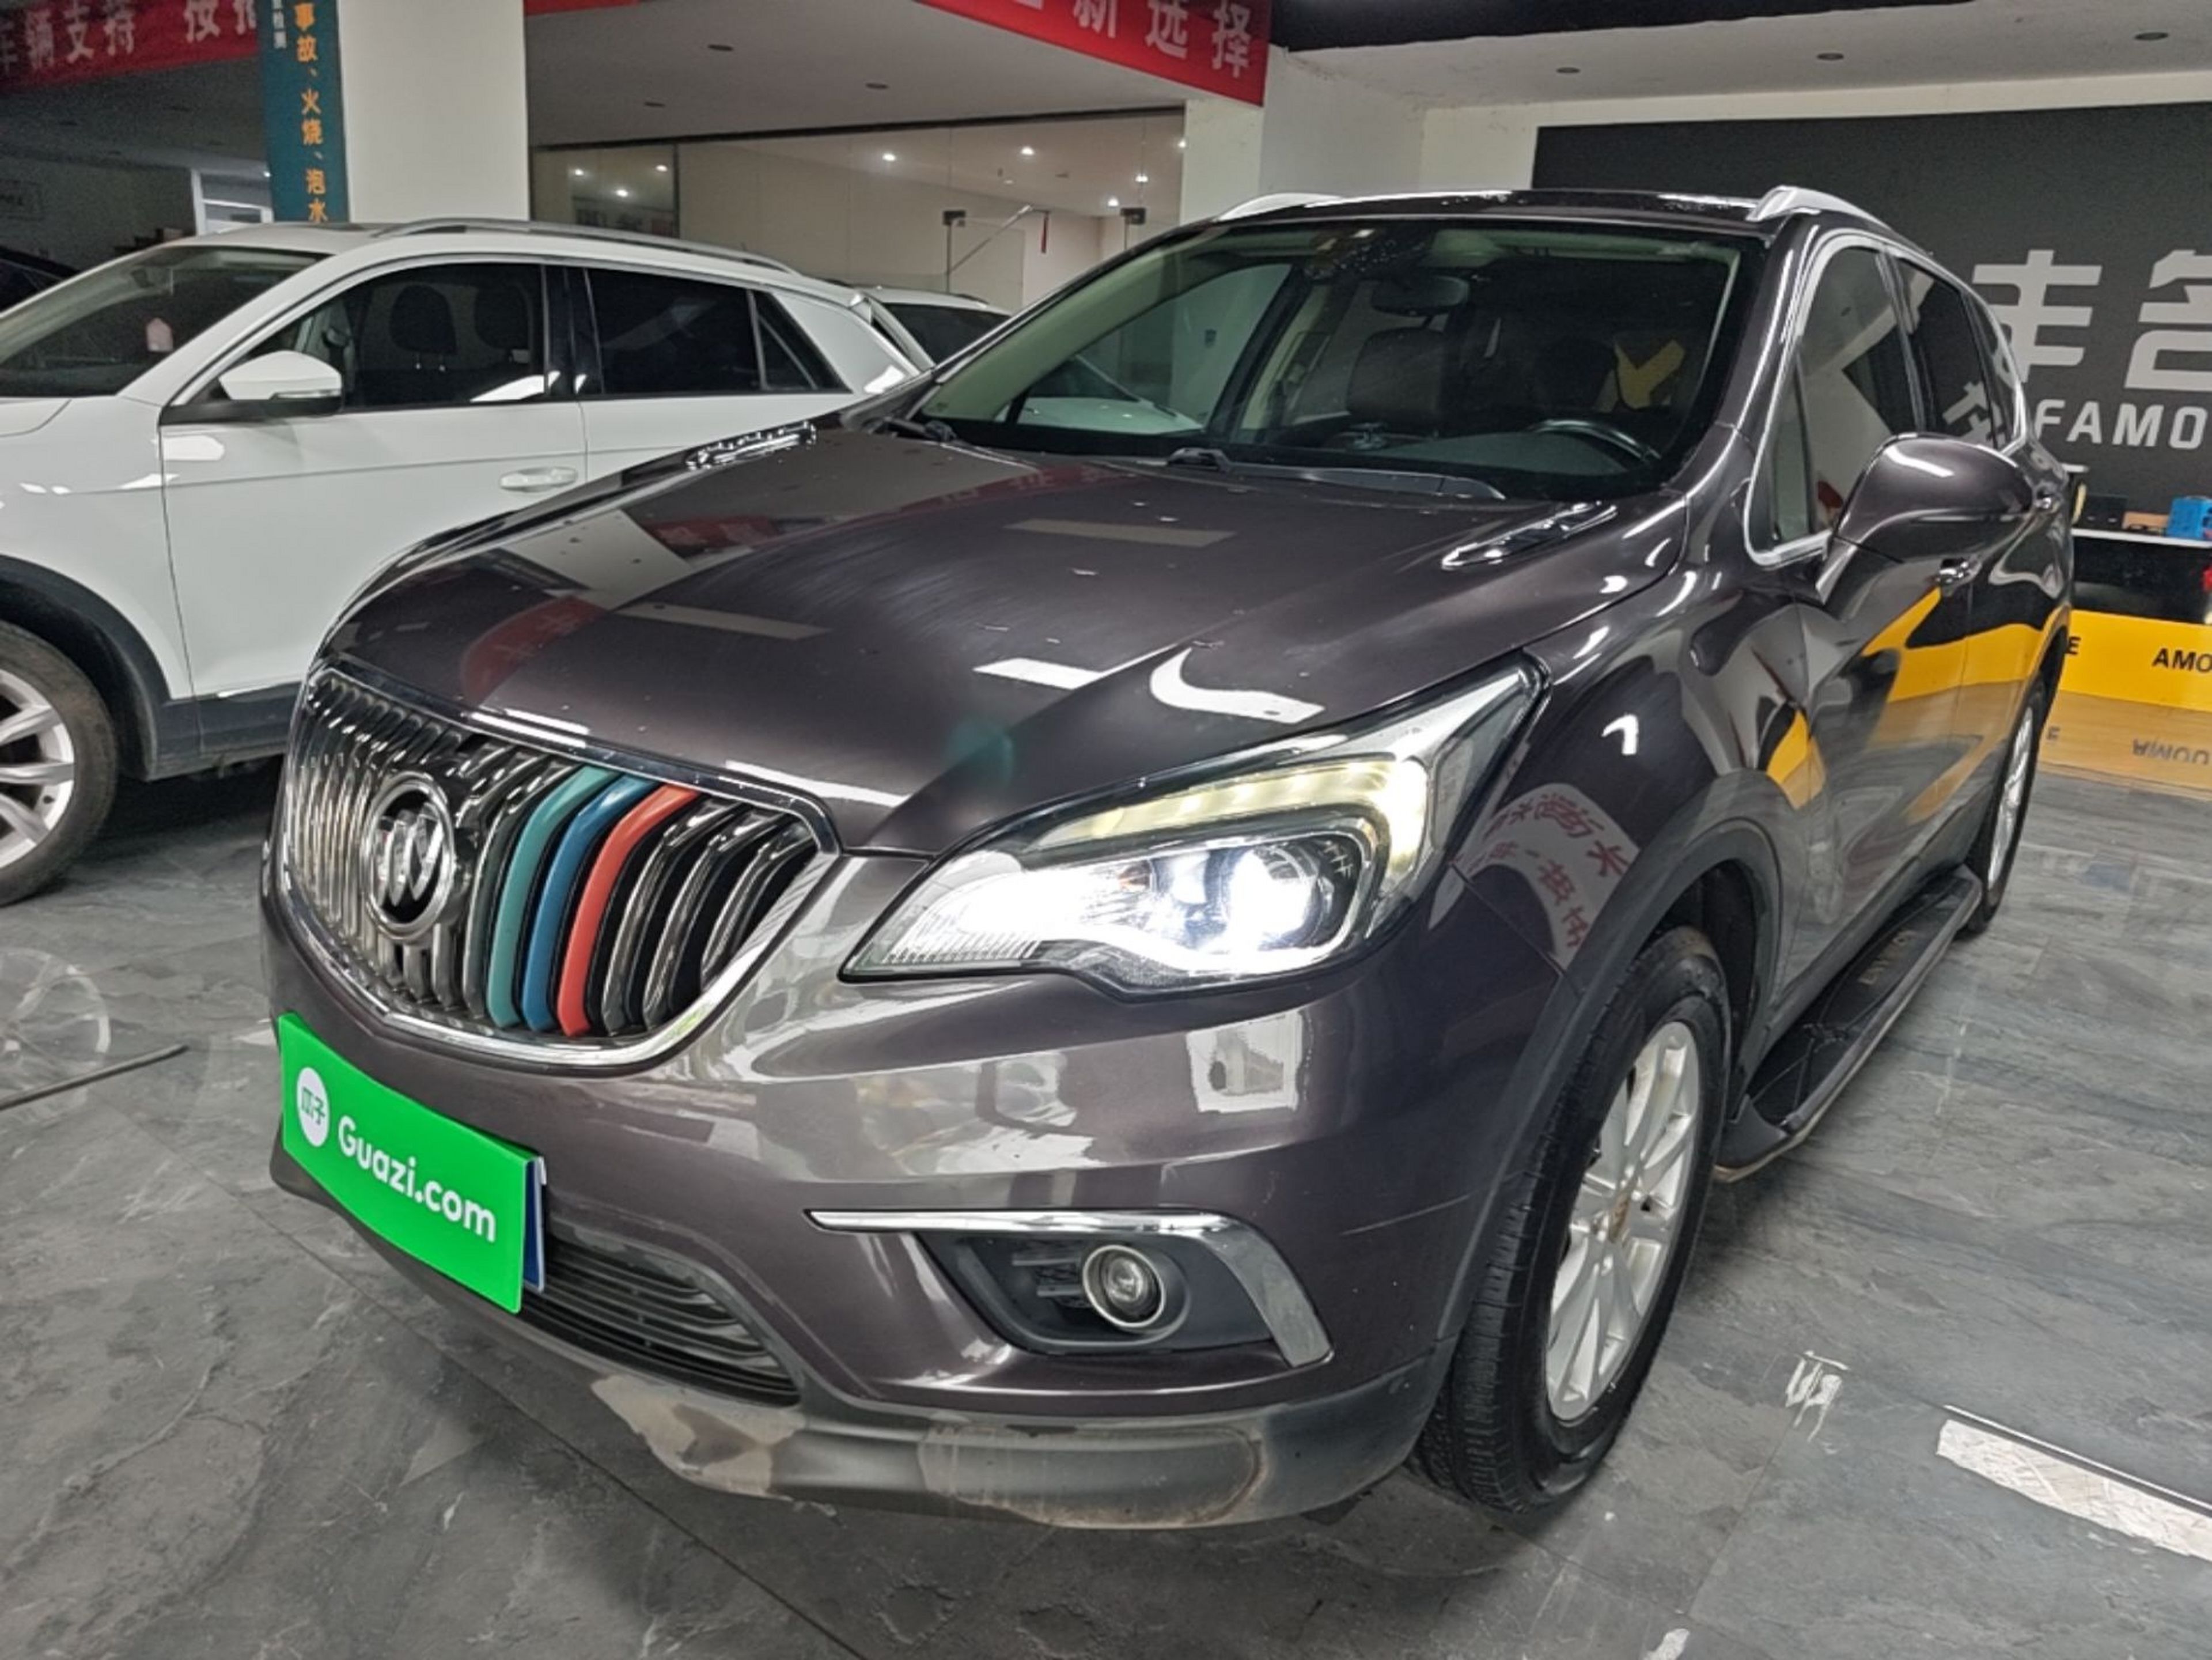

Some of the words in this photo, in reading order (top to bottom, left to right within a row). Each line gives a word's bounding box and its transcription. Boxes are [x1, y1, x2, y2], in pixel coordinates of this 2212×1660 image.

[1015, 0, 1250, 78] 新选择
[2035, 399, 2207, 448] FAMO
[339, 1116, 496, 1242] Guazi.com
